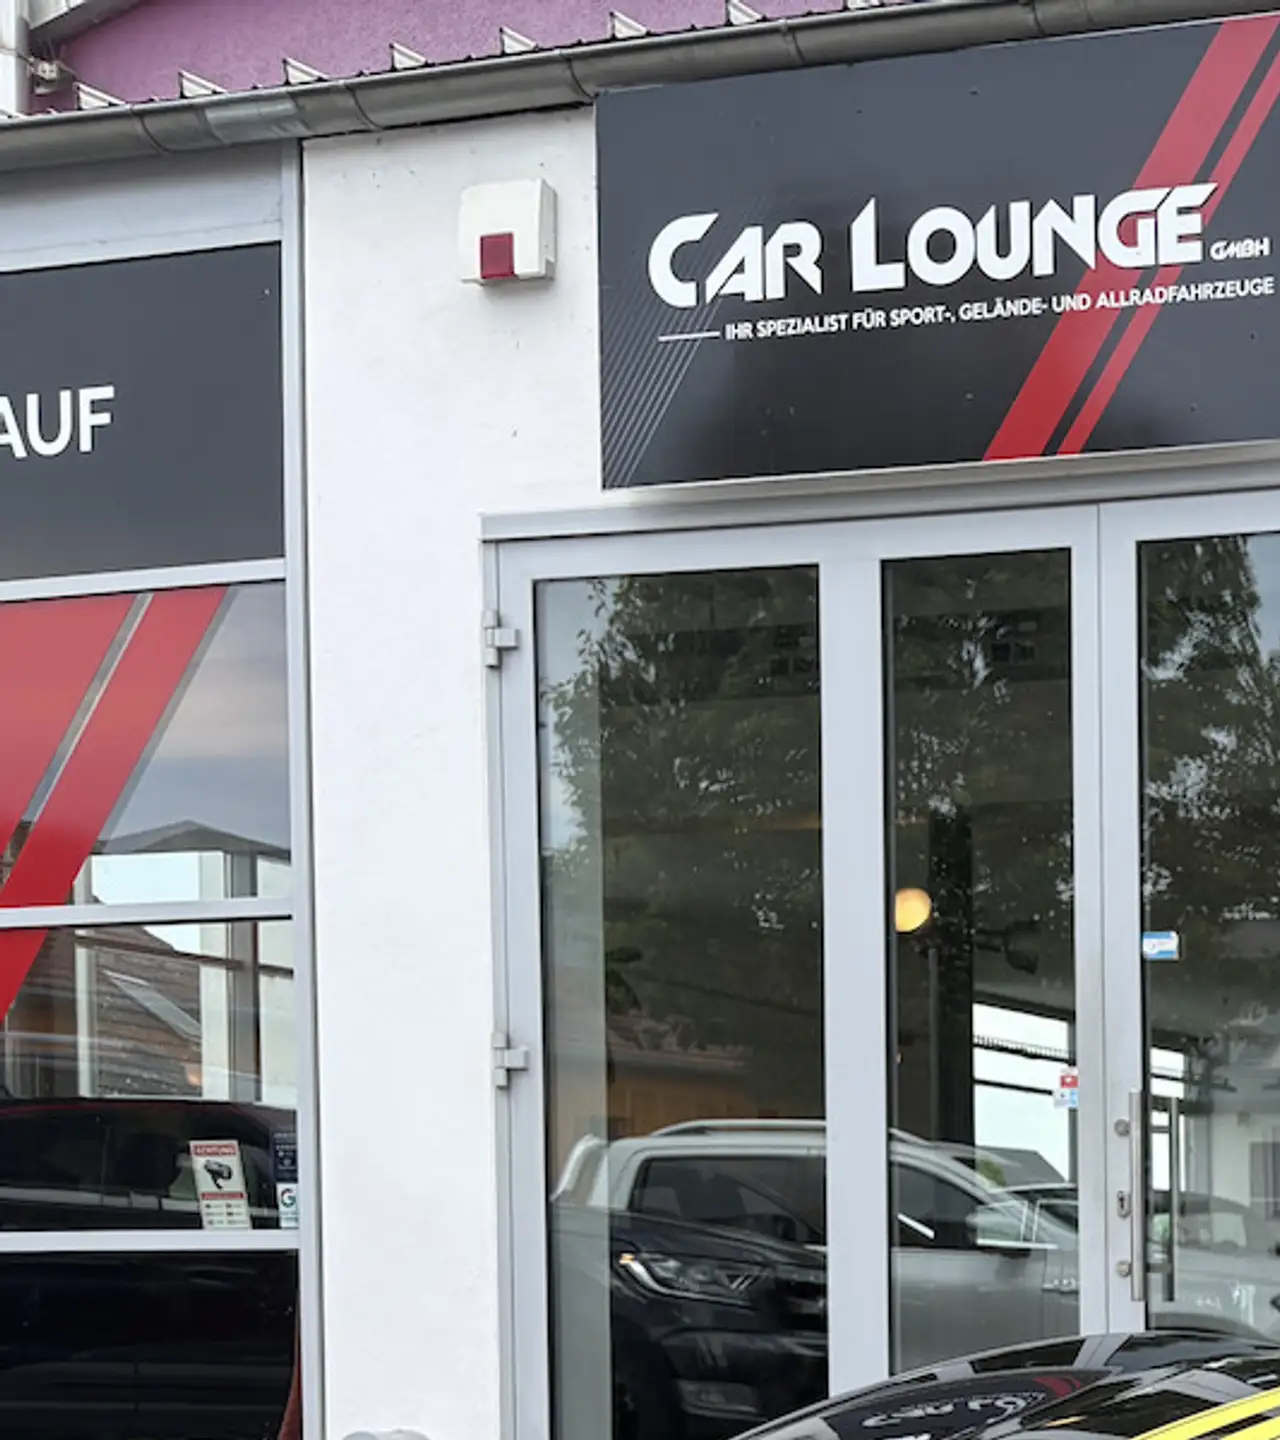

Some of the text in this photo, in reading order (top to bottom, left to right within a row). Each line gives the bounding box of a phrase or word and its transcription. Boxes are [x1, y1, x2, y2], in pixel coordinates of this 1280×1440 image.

[648, 212, 822, 308] CAR
[850, 183, 1218, 292] LOUNGE
[725, 276, 1275, 340] IHR SPEZIALIST FÜR SPORT-, GELÄNDE- UND ALLRADFAHRZEUGE
